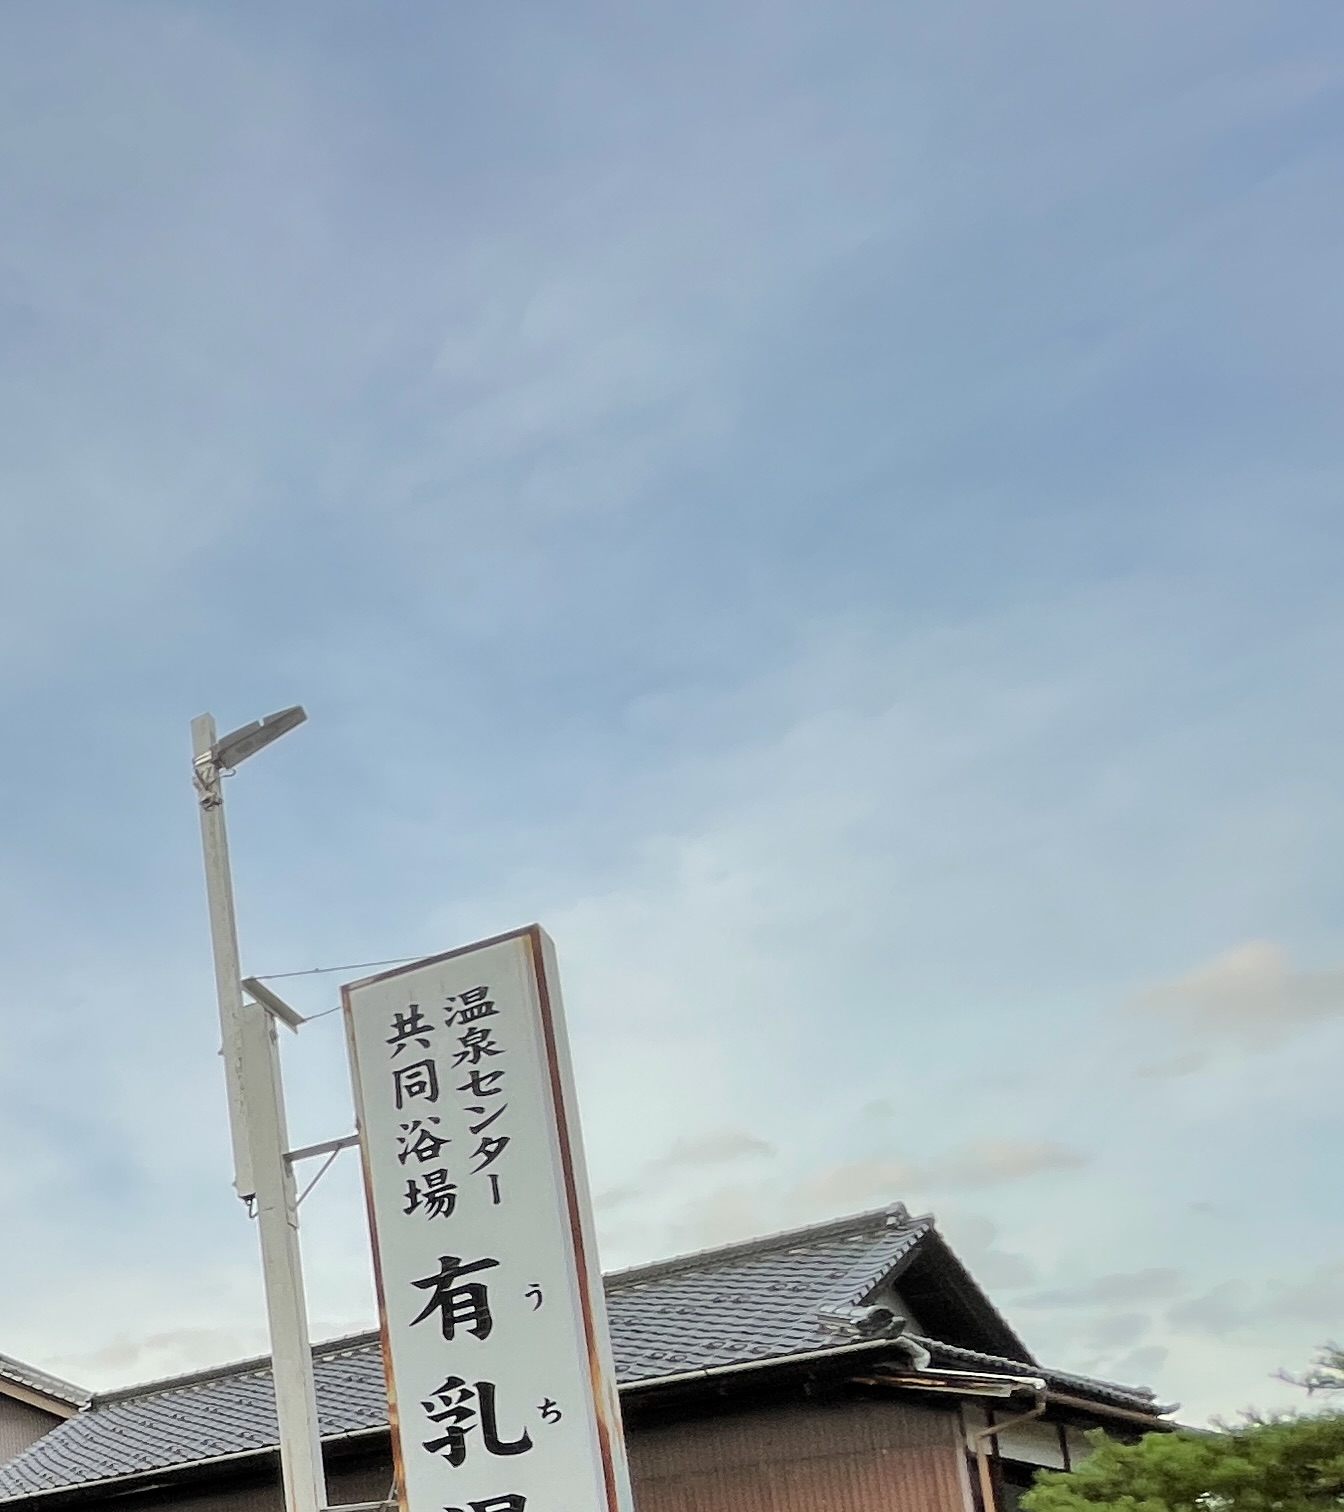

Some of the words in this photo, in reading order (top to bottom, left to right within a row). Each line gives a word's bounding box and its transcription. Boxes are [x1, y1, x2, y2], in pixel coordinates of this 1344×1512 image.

[385, 1004, 458, 1221] 共同浴場
[444, 985, 510, 1204] 温泉センター
